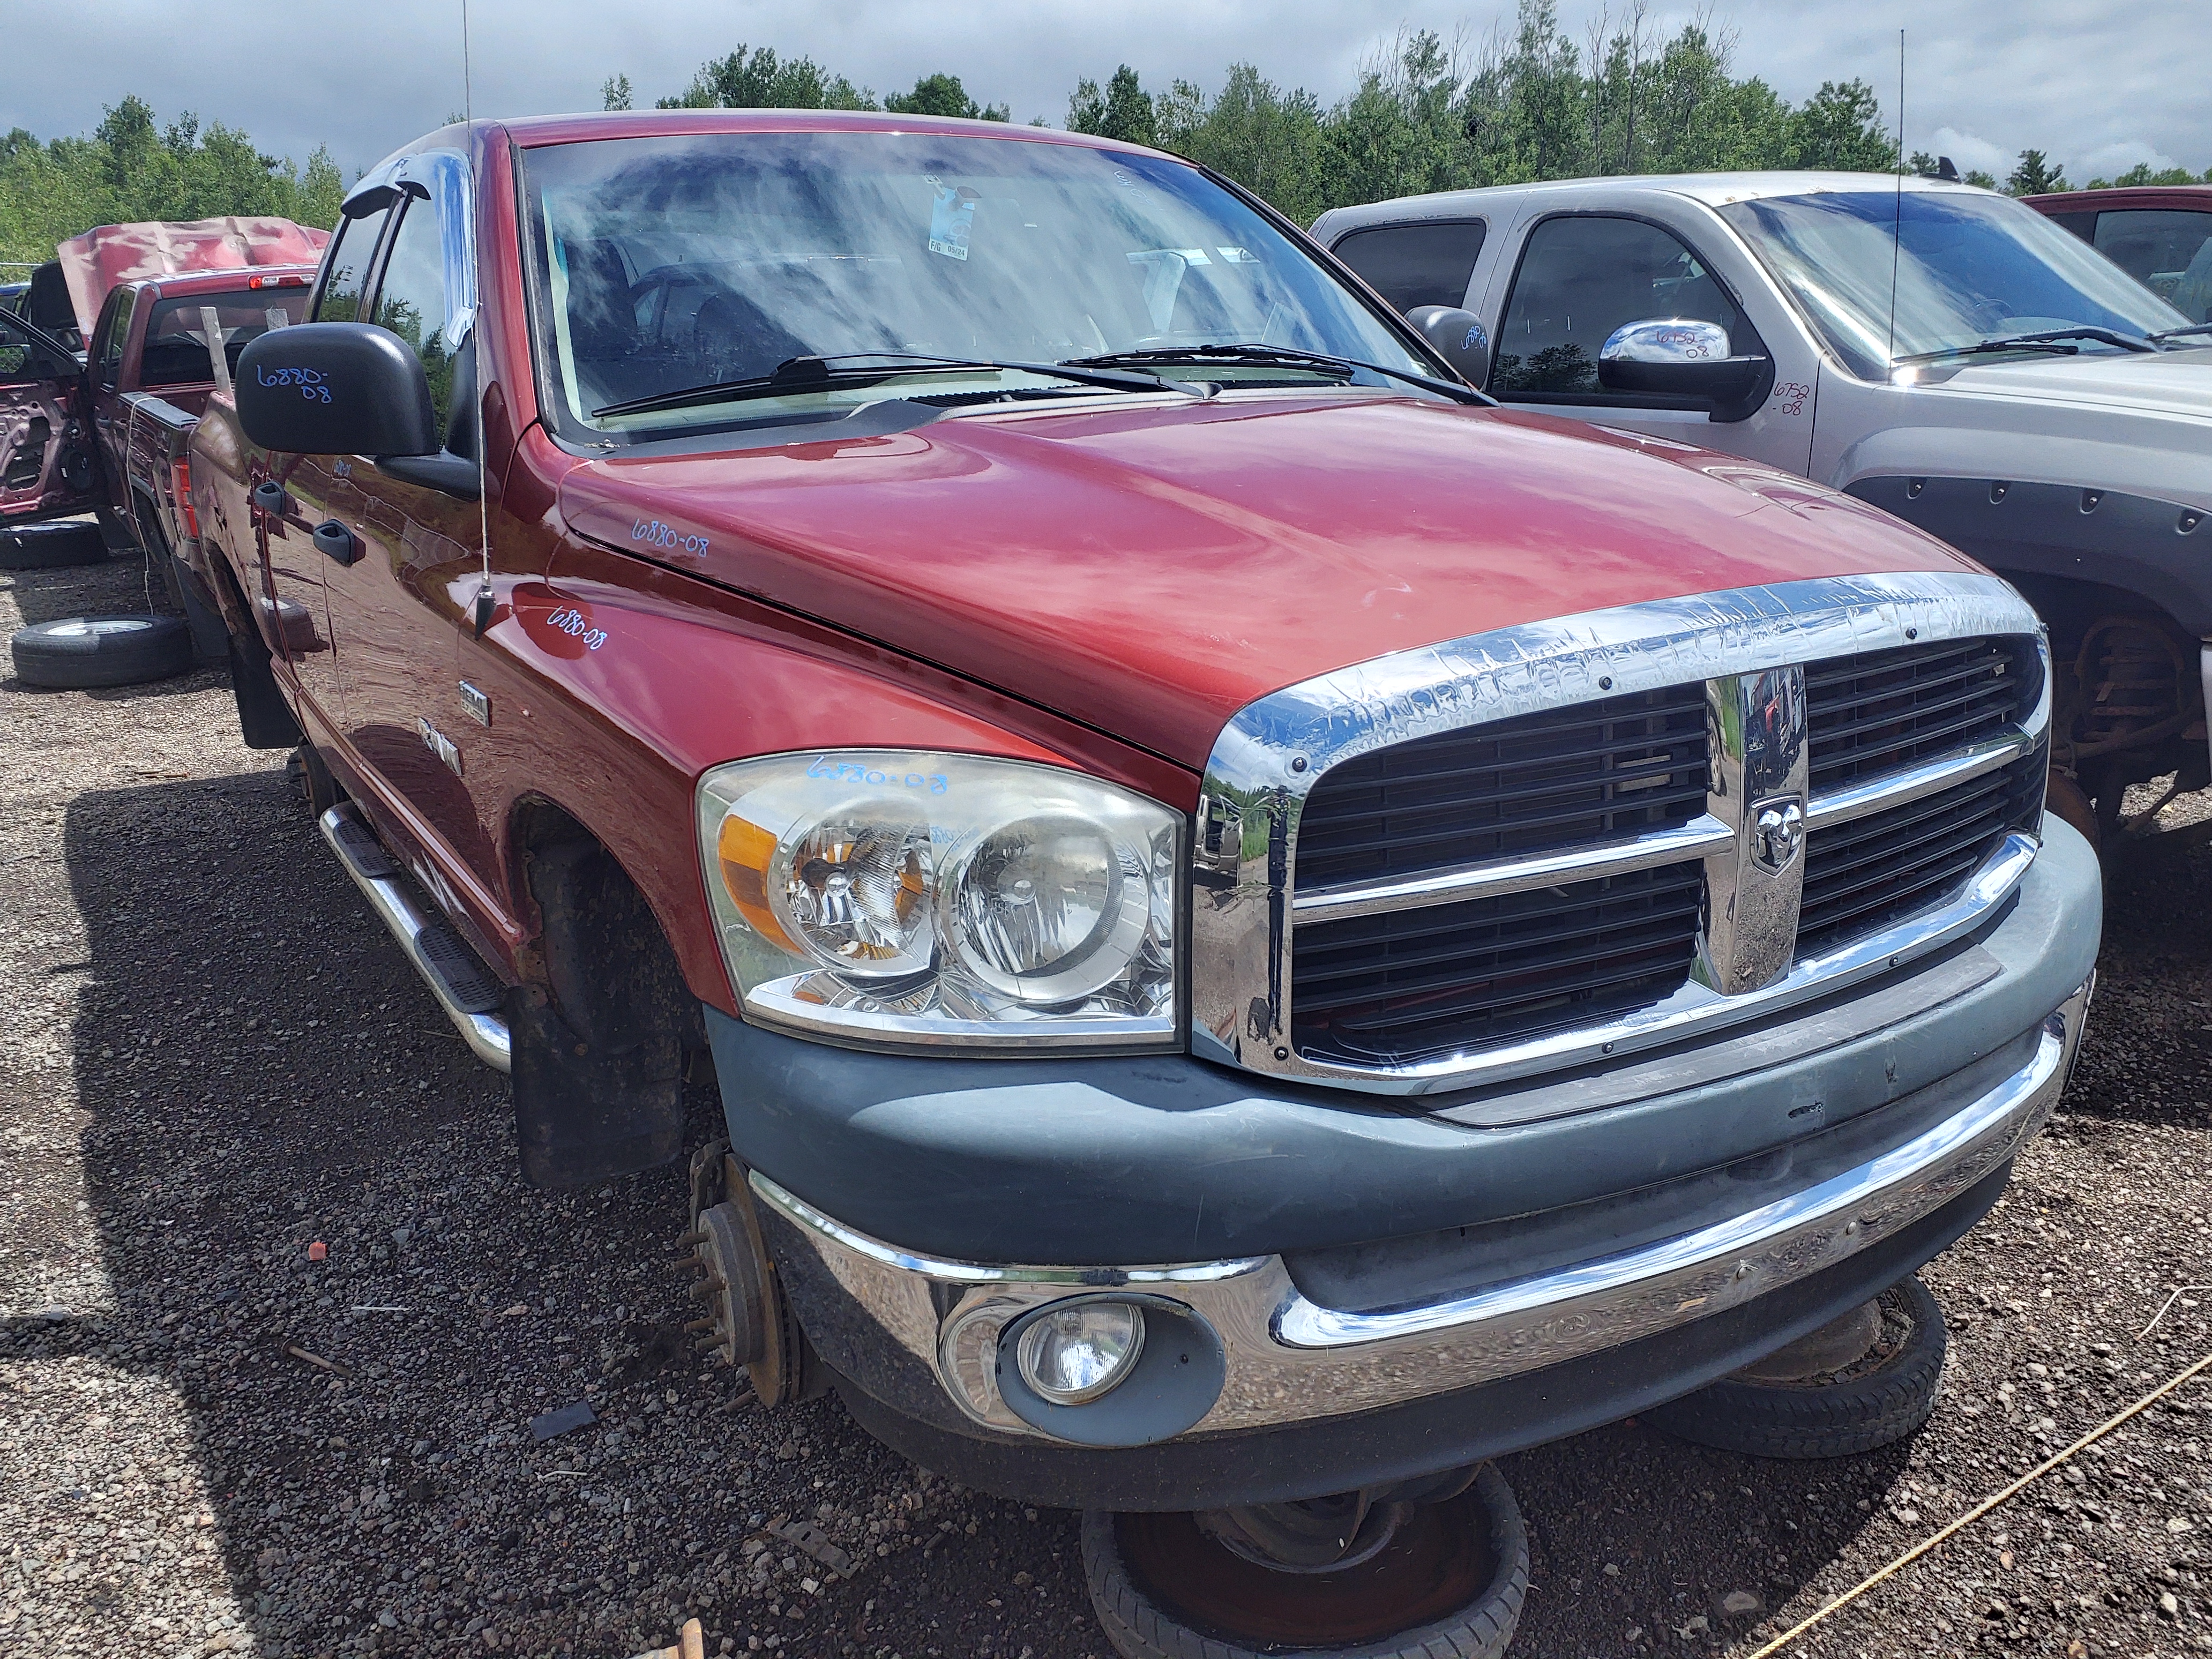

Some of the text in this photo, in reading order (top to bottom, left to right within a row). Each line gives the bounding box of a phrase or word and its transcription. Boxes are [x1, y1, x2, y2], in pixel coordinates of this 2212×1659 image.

[931, 241, 965, 256] F/G 05/24
[1686, 345, 1709, 358] 08
[257, 364, 328, 387] 6880-
[301, 385, 333, 403] 08
[1774, 382, 1810, 400] 6752
[631, 518, 709, 557] 6880-08
[547, 606, 608, 650] 6880-08
[806, 756, 948, 795] 6880-08
